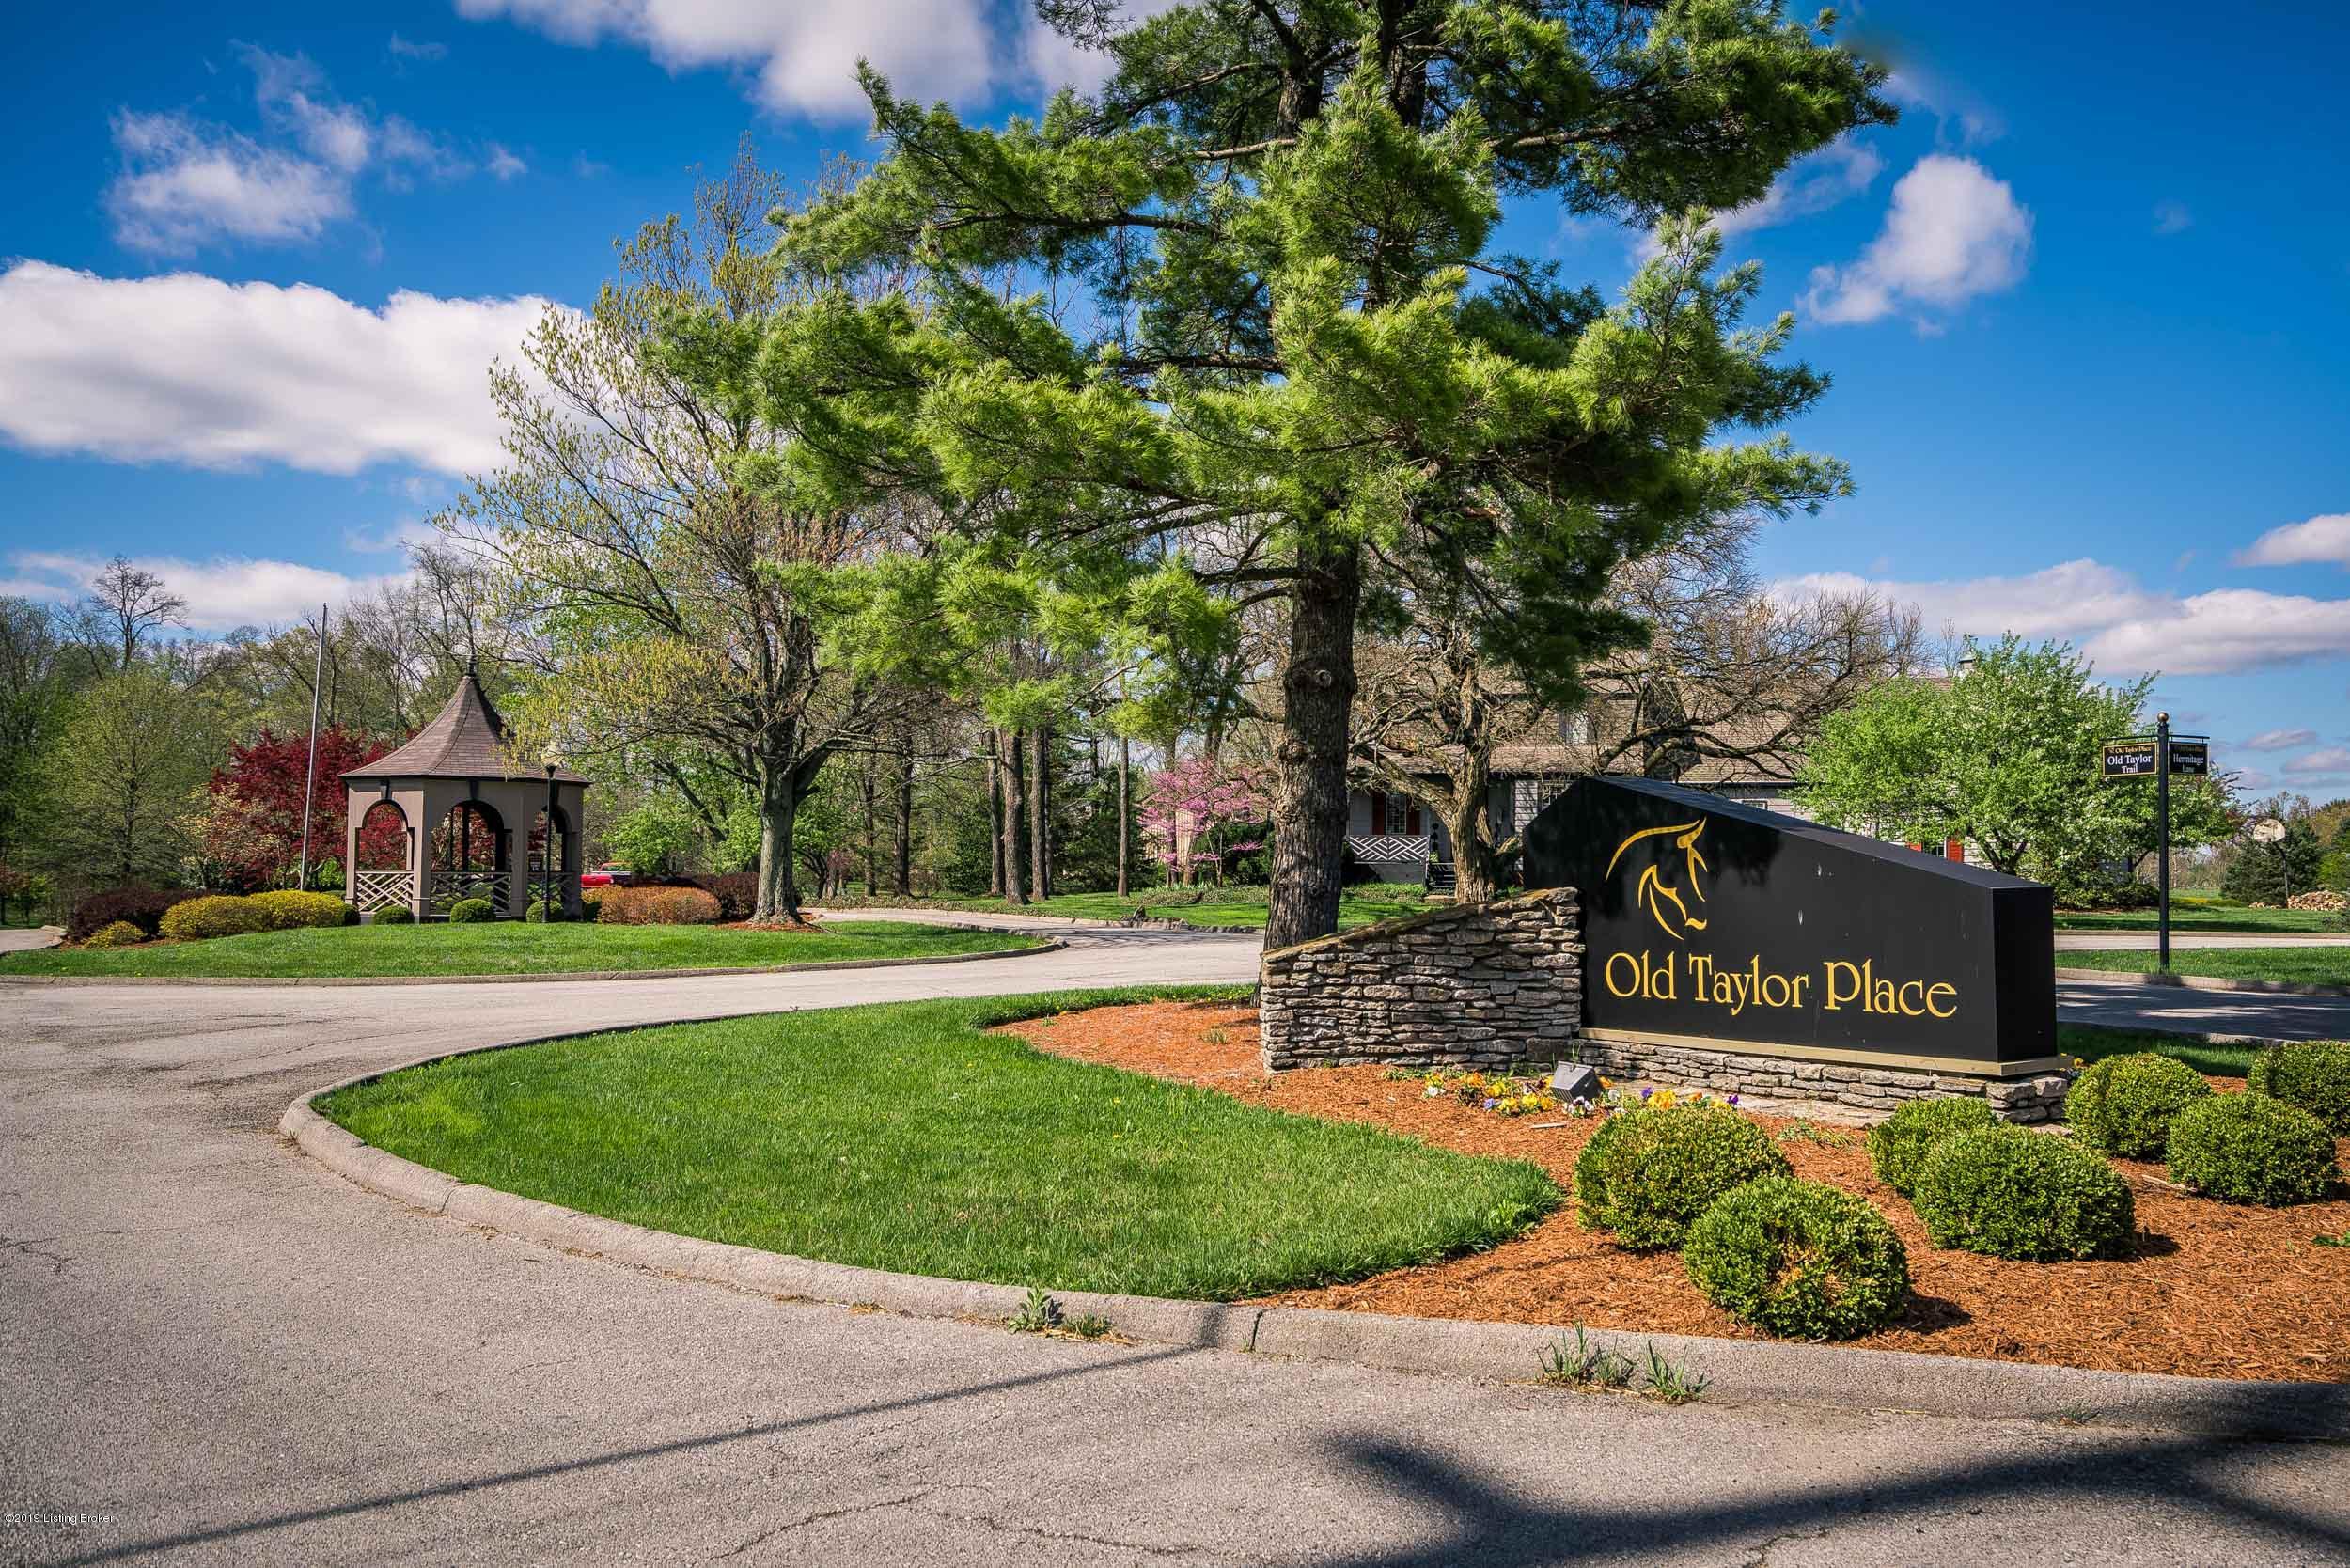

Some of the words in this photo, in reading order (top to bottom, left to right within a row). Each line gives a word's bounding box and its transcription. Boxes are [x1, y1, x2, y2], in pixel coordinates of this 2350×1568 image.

[2107, 755, 2123, 766] Old
[2124, 754, 2153, 764] Taylor
[2172, 753, 2204, 766] Hermitage
[2122, 764, 2138, 774] Trail
[1606, 949, 1678, 1000] Old
[1688, 953, 1810, 1016] Taylor
[1824, 958, 1958, 1018] Place
